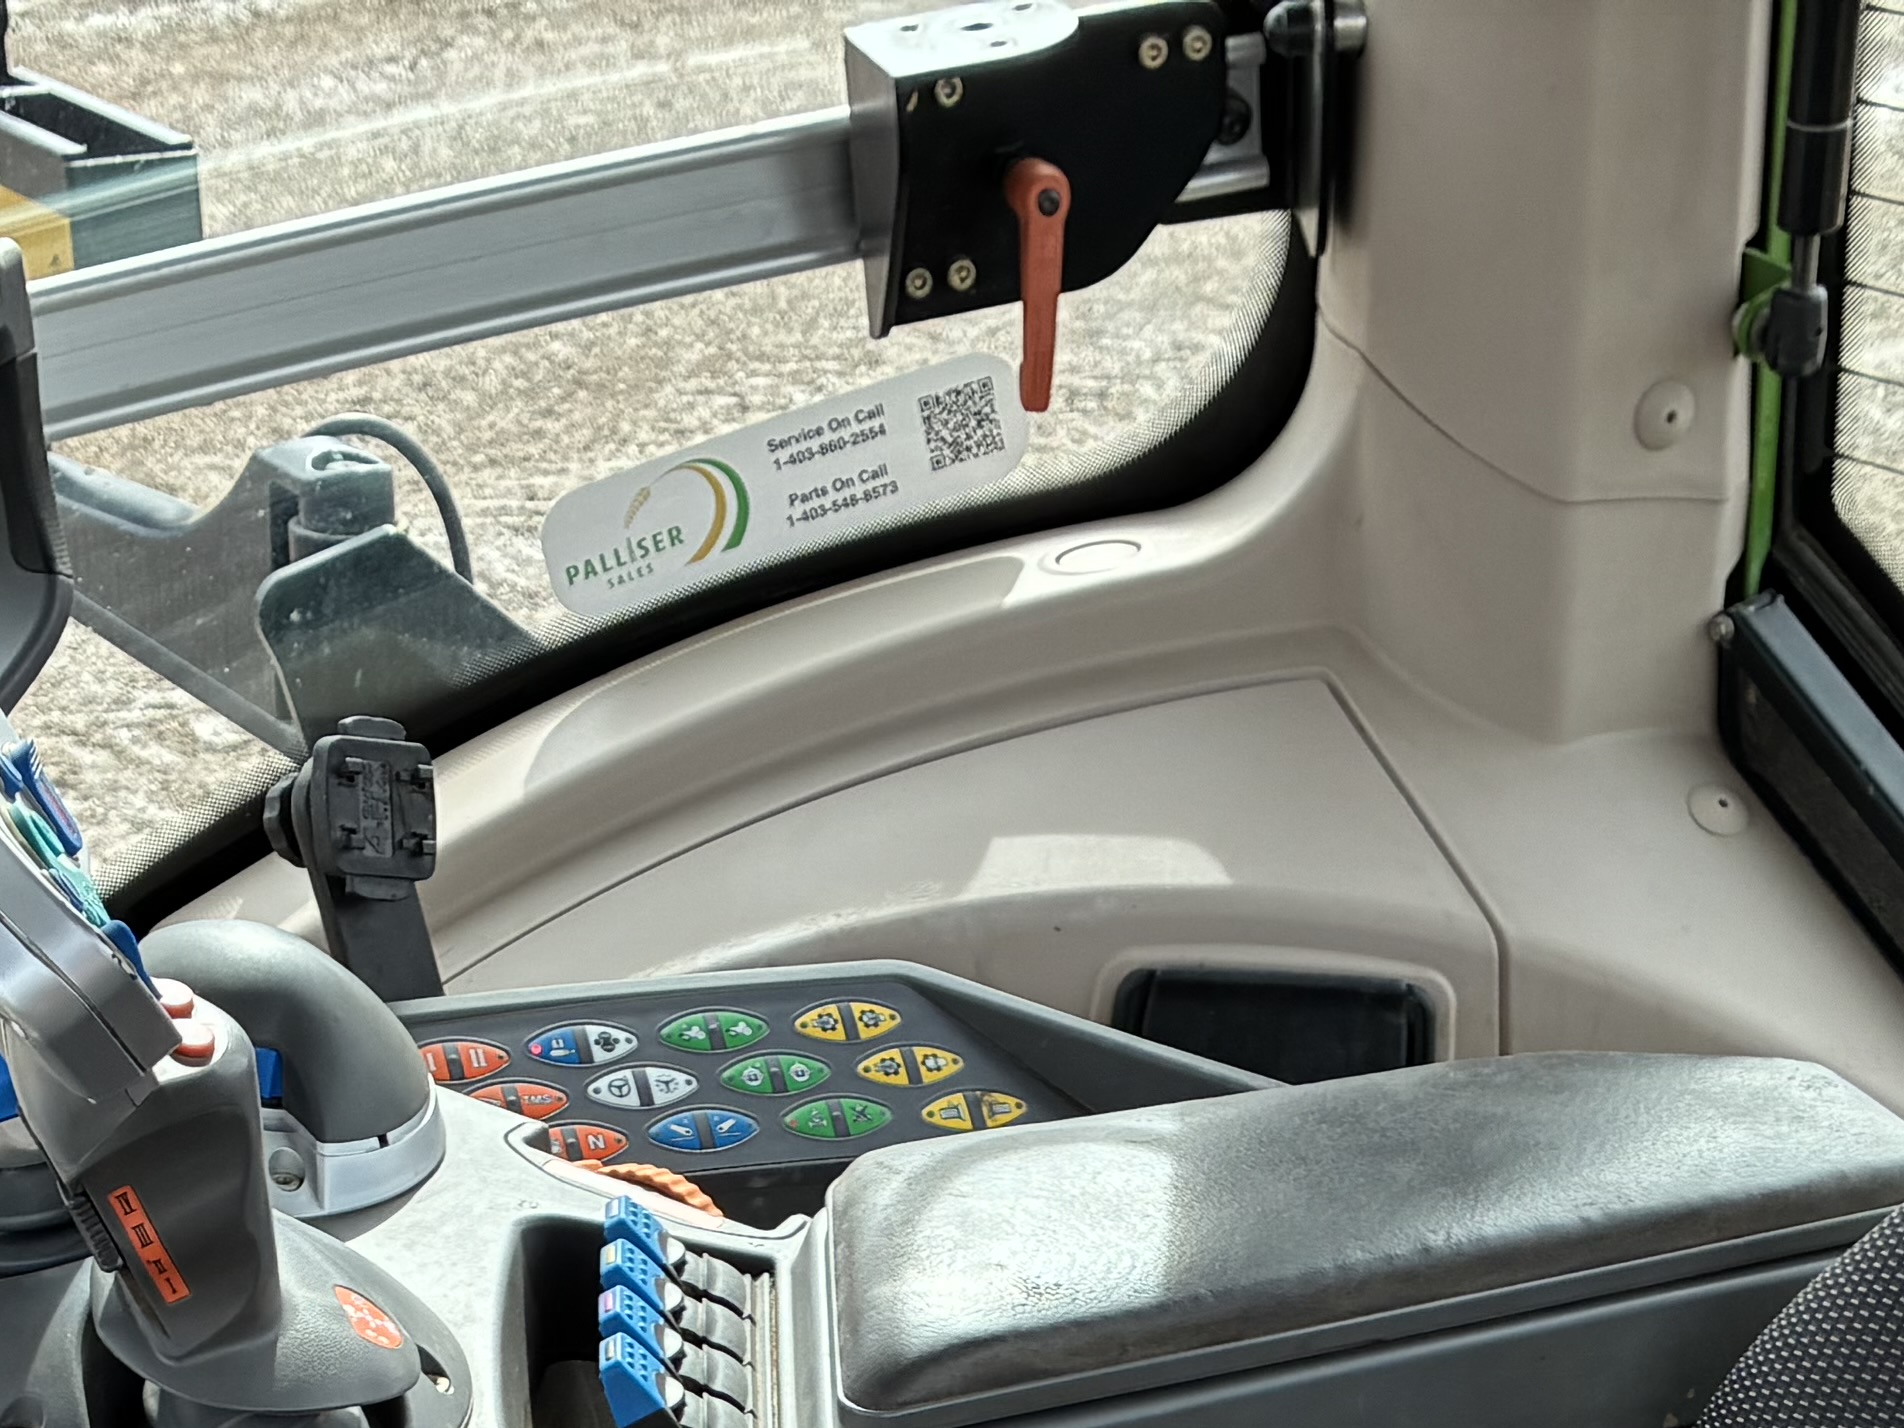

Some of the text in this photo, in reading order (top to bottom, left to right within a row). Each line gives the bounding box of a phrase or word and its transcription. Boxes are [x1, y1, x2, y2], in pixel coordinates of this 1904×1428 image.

[766, 402, 885, 453] Service On Call
[788, 462, 889, 508] Parts On Call
[565, 525, 685, 586] PALLISER
[607, 562, 654, 590] SALES
[585, 1133, 607, 1151] N
